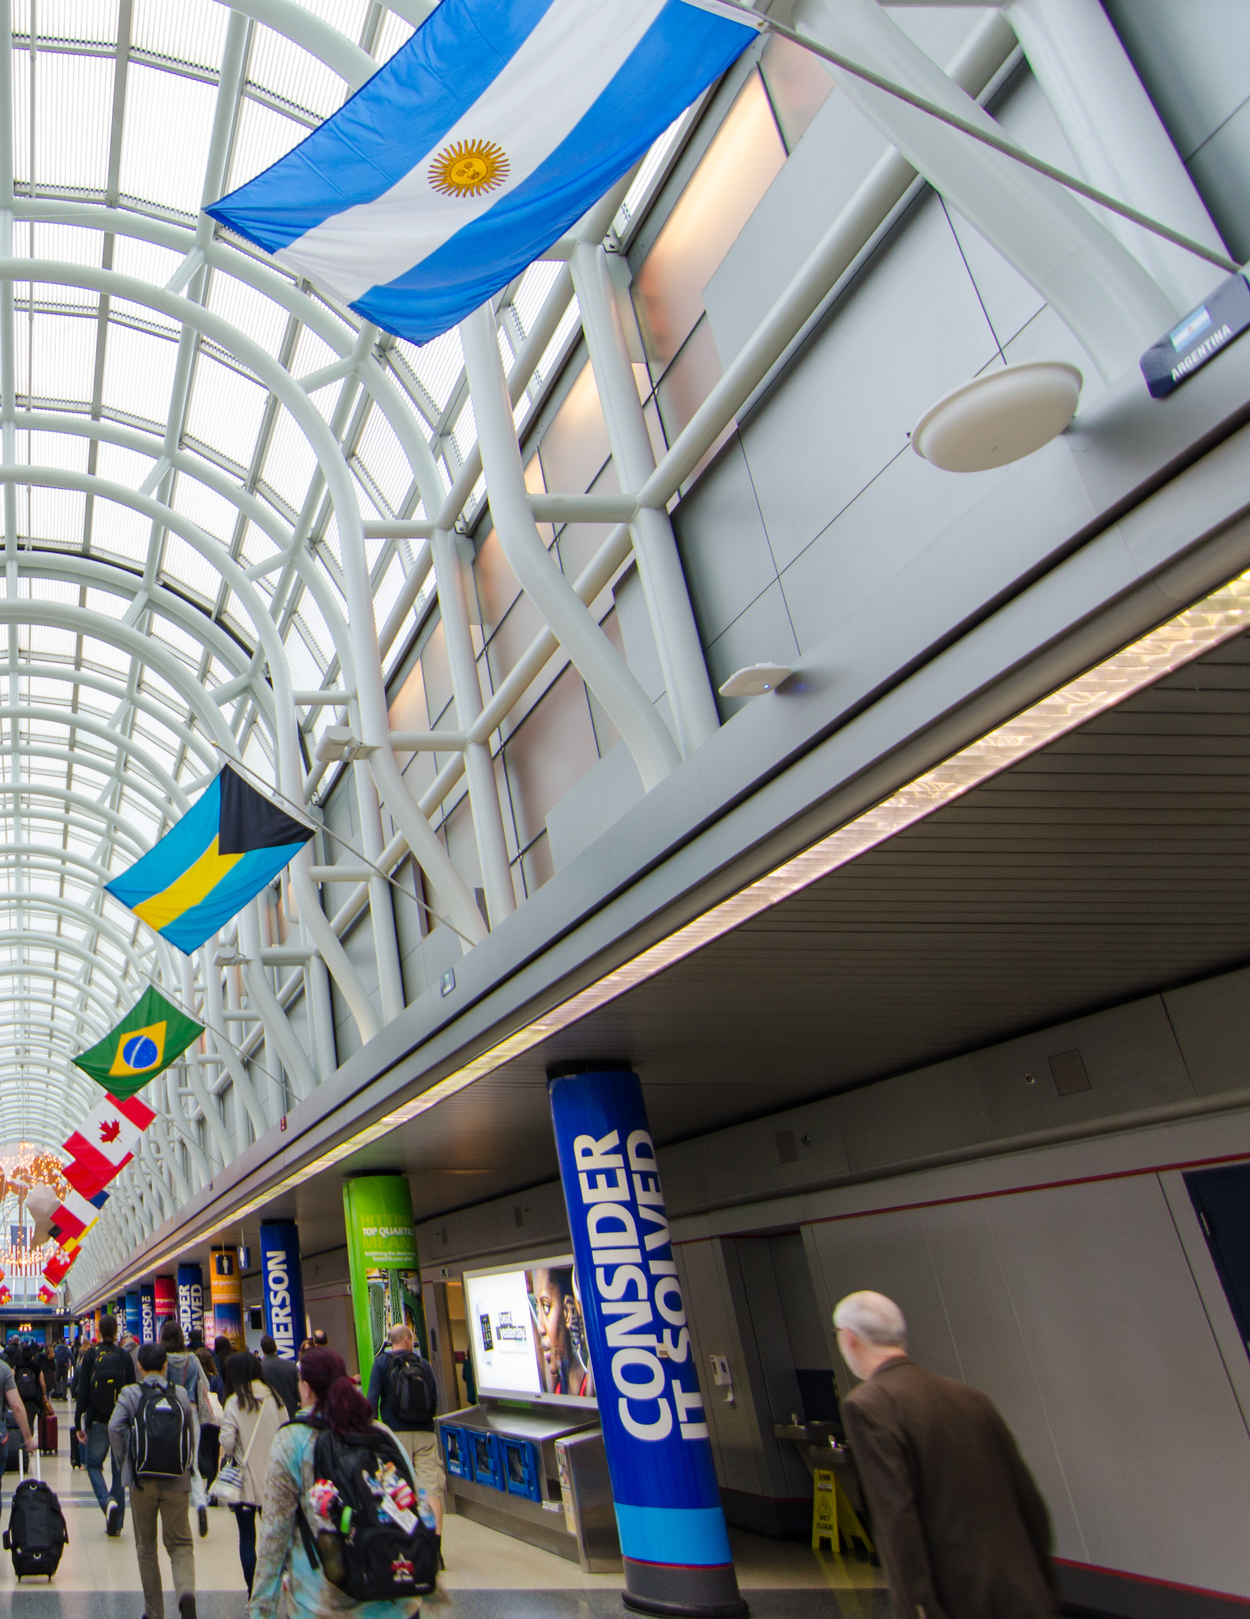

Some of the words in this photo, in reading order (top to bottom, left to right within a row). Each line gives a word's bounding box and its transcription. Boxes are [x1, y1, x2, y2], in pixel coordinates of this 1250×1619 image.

[1171, 324, 1232, 381] ARGENTINA
[362, 1227, 378, 1237] TOP
[626, 1129, 695, 1363] SOLVED
[178, 1284, 192, 1345] SIDER
[266, 1250, 296, 1361] MERSON
[573, 1129, 673, 1441] CONSIDER
[142, 1303, 154, 1342] ERSON
[671, 1379, 709, 1440] IT
[816, 1522, 833, 1530] FLOOR
